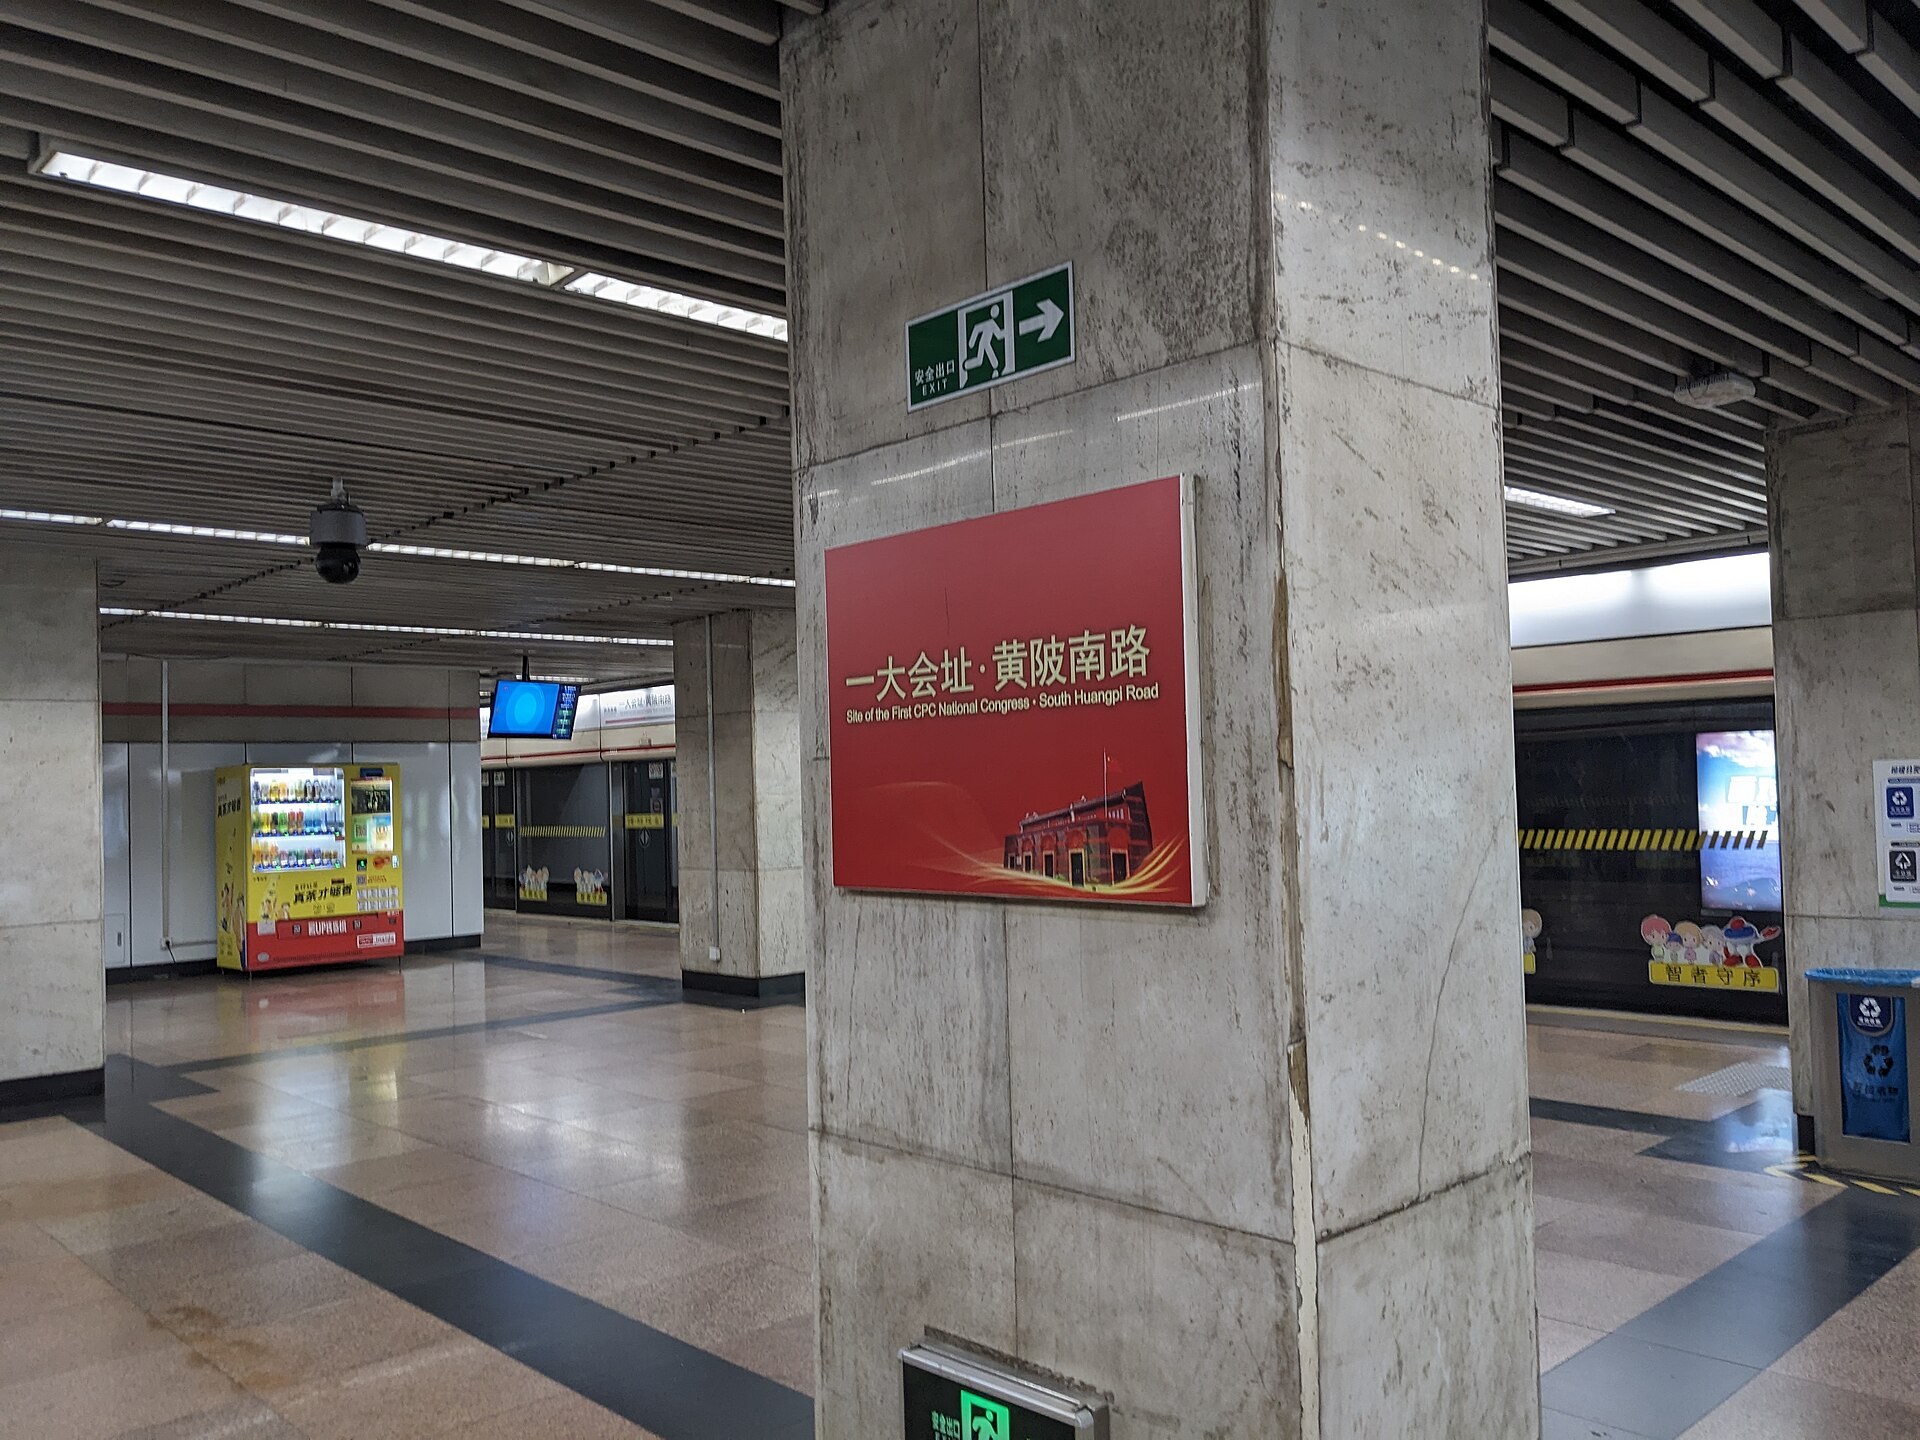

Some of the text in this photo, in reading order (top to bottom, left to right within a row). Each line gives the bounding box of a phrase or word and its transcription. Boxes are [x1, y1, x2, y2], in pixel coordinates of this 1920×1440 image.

[915, 359, 955, 386] 安全出口
[922, 378, 948, 396] EXIT
[846, 624, 1151, 702] 一大会址·黄陂南路
[846, 682, 1159, 723] Site of the First CPC National Congress South Huangpi Road
